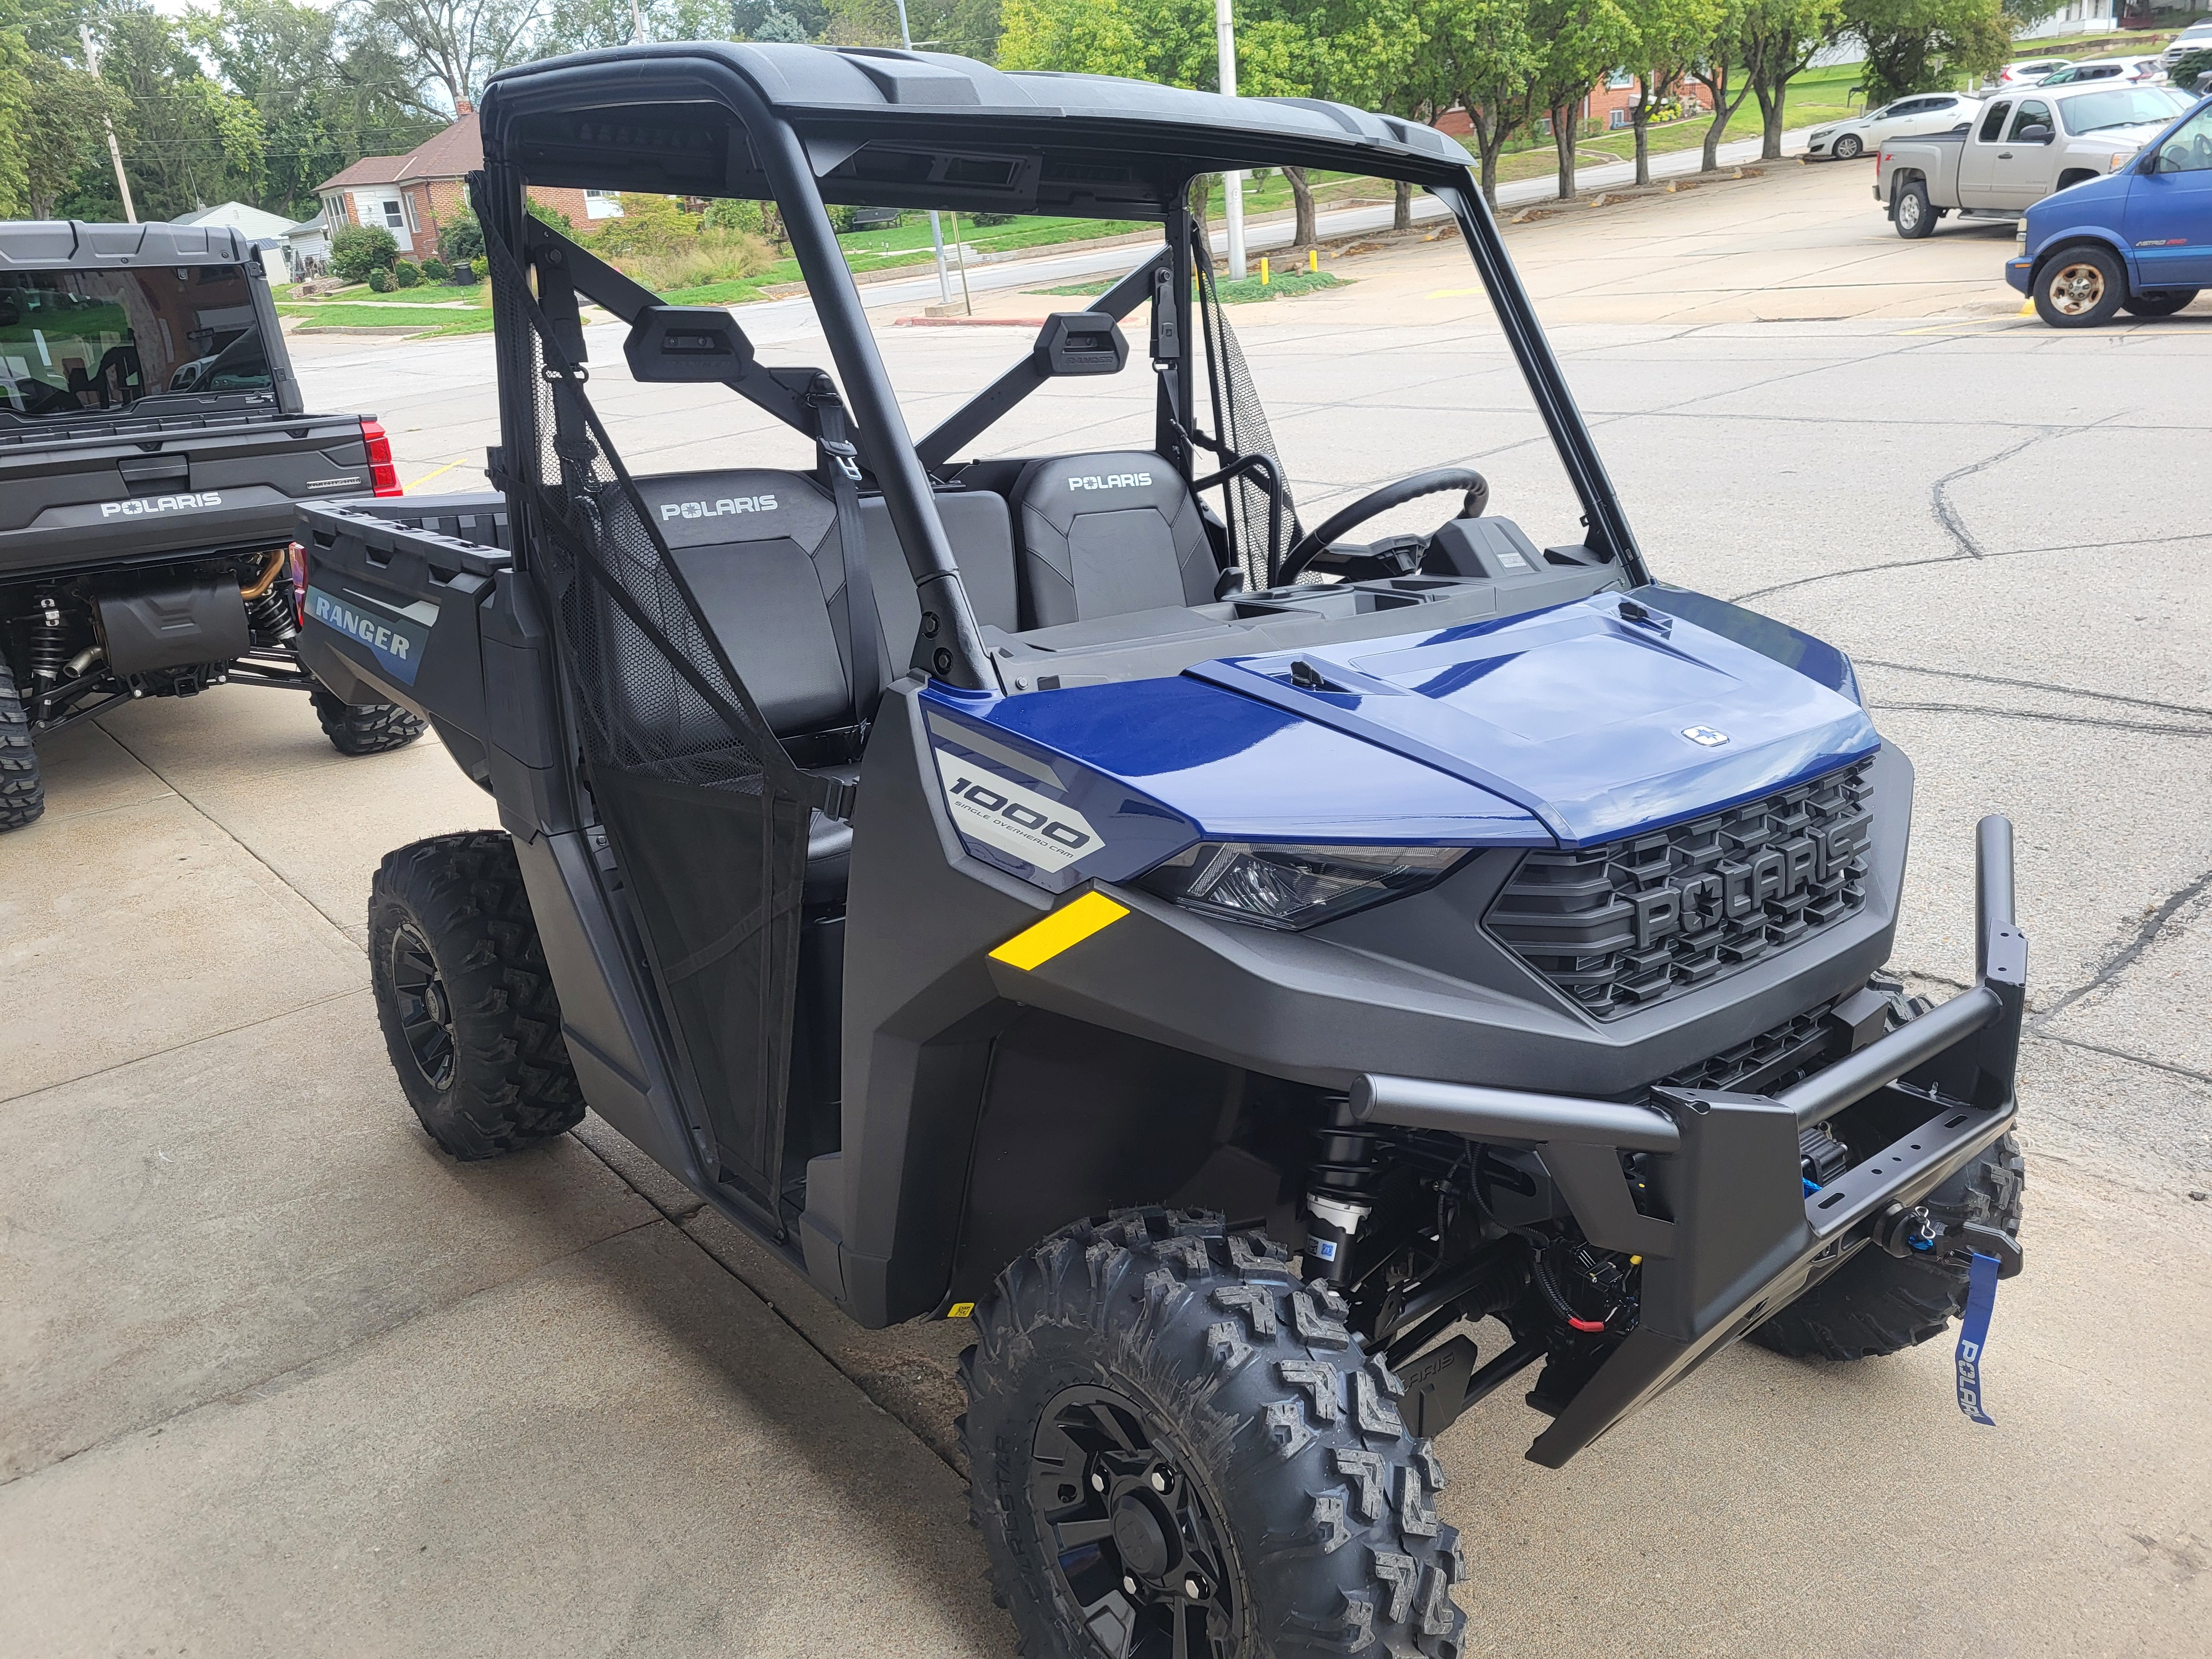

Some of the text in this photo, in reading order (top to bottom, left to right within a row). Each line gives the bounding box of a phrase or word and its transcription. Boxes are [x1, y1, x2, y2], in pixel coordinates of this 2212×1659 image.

[100, 492, 222, 517] POLARIS
[660, 494, 778, 521] POLARIS
[1068, 472, 1152, 491] POLARIS
[316, 596, 410, 660] RANGER
[949, 777, 1091, 849] 1000
[954, 801, 1074, 858] SINGLE OVERHEAD CAM
[1632, 822, 1854, 950] POLARIS
